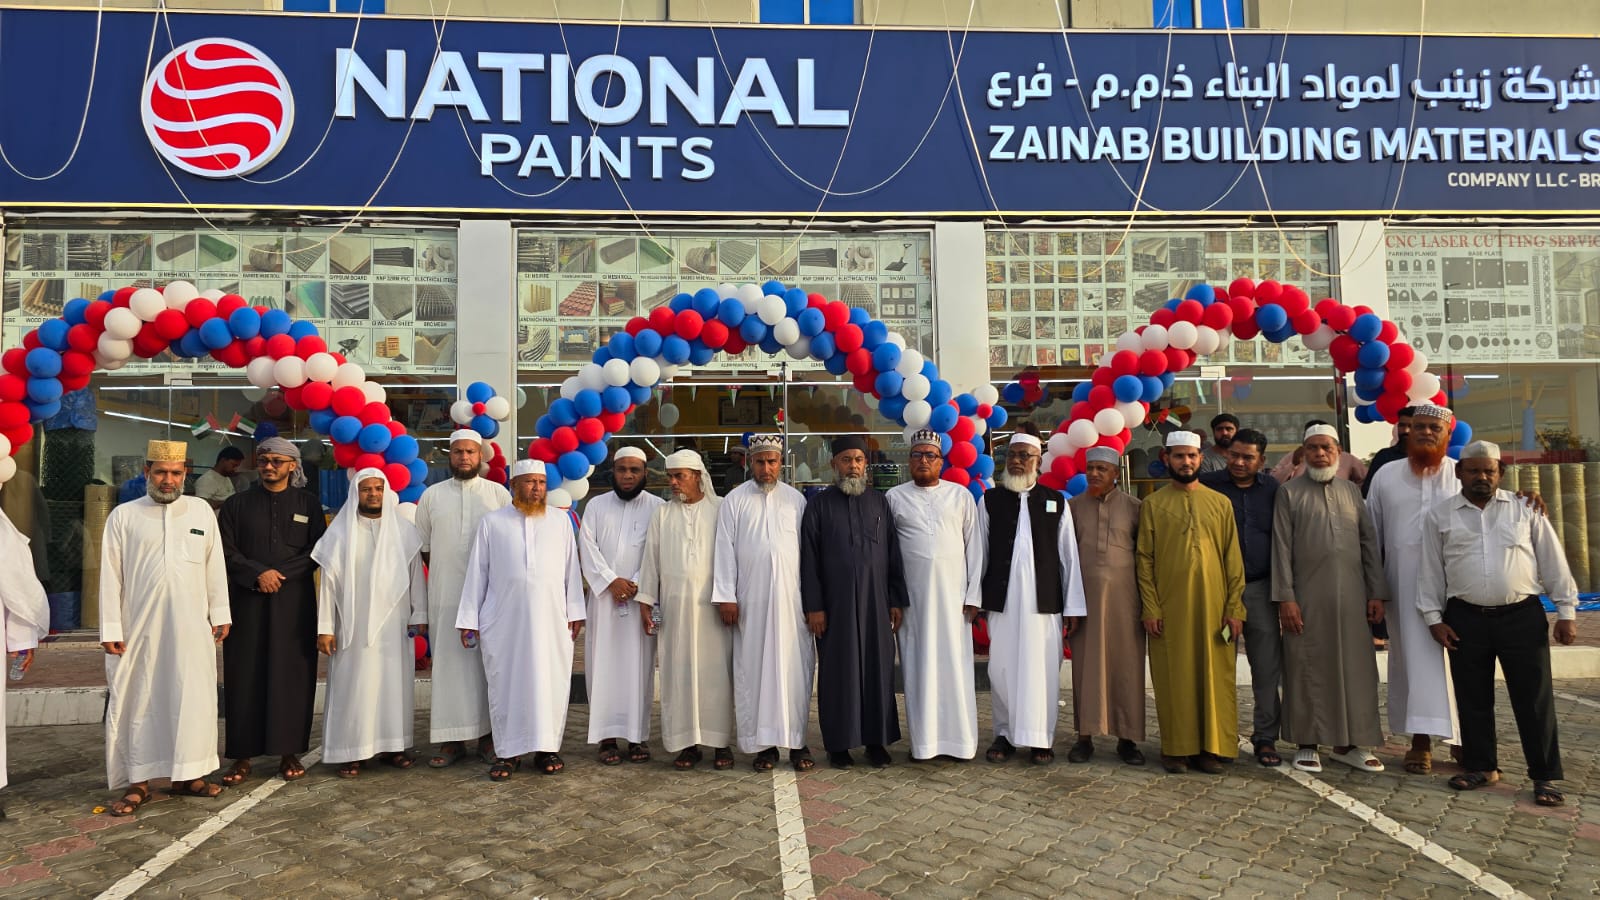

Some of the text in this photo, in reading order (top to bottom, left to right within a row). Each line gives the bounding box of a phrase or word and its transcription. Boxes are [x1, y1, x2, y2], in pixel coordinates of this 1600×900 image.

[334, 47, 850, 127] NATIONAL
[987, 62, 1053, 108] فرع
[1205, 61, 1290, 107] البناء
[1302, 63, 1400, 109] لمواد
[1411, 68, 1492, 109] زينب
[1502, 64, 1600, 109] شركة
[480, 133, 715, 181] PAINTS
[989, 125, 1600, 162] ZAINAB BUILDING MATERIALS
[1447, 172, 1531, 188] COMPANY
[1385, 234, 1417, 248] CNC
[1421, 234, 1469, 248] LASER
[1473, 234, 1545, 248] CUTTING
